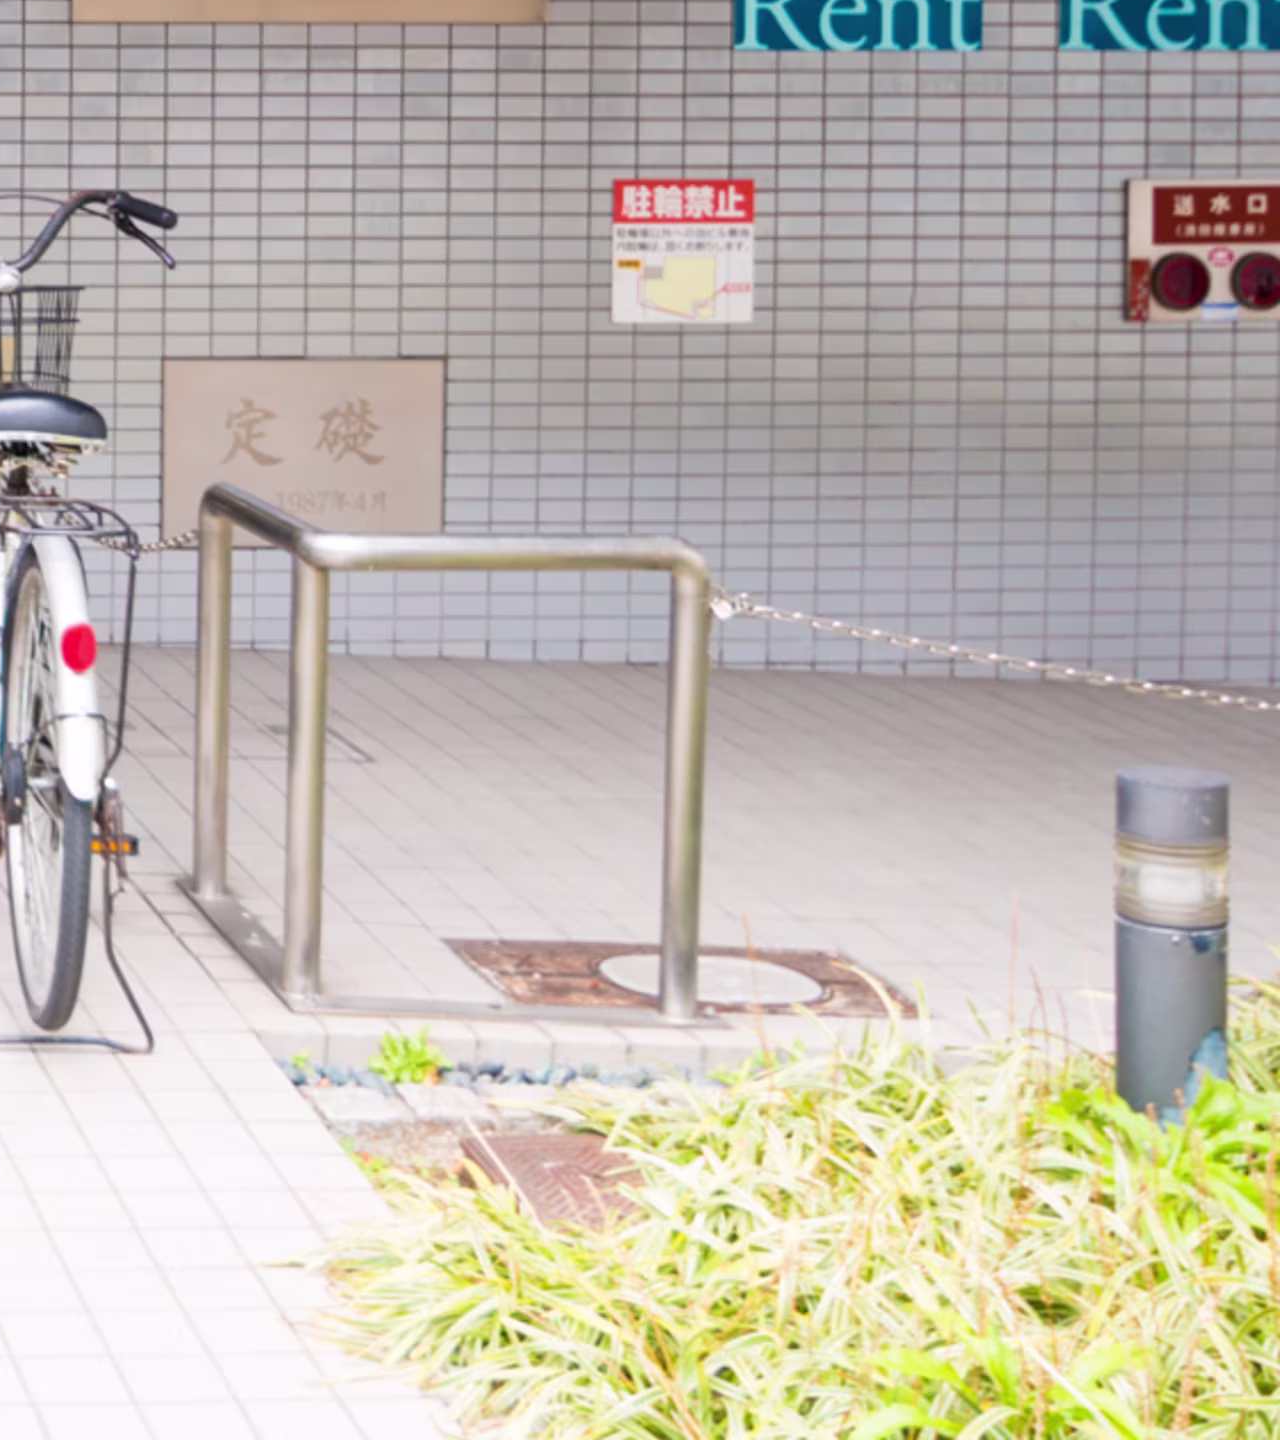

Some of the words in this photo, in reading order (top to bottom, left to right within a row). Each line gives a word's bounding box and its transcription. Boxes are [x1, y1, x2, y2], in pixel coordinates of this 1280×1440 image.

[621, 185, 746, 219] 駐輪禁止
[222, 398, 386, 466] 定礎
